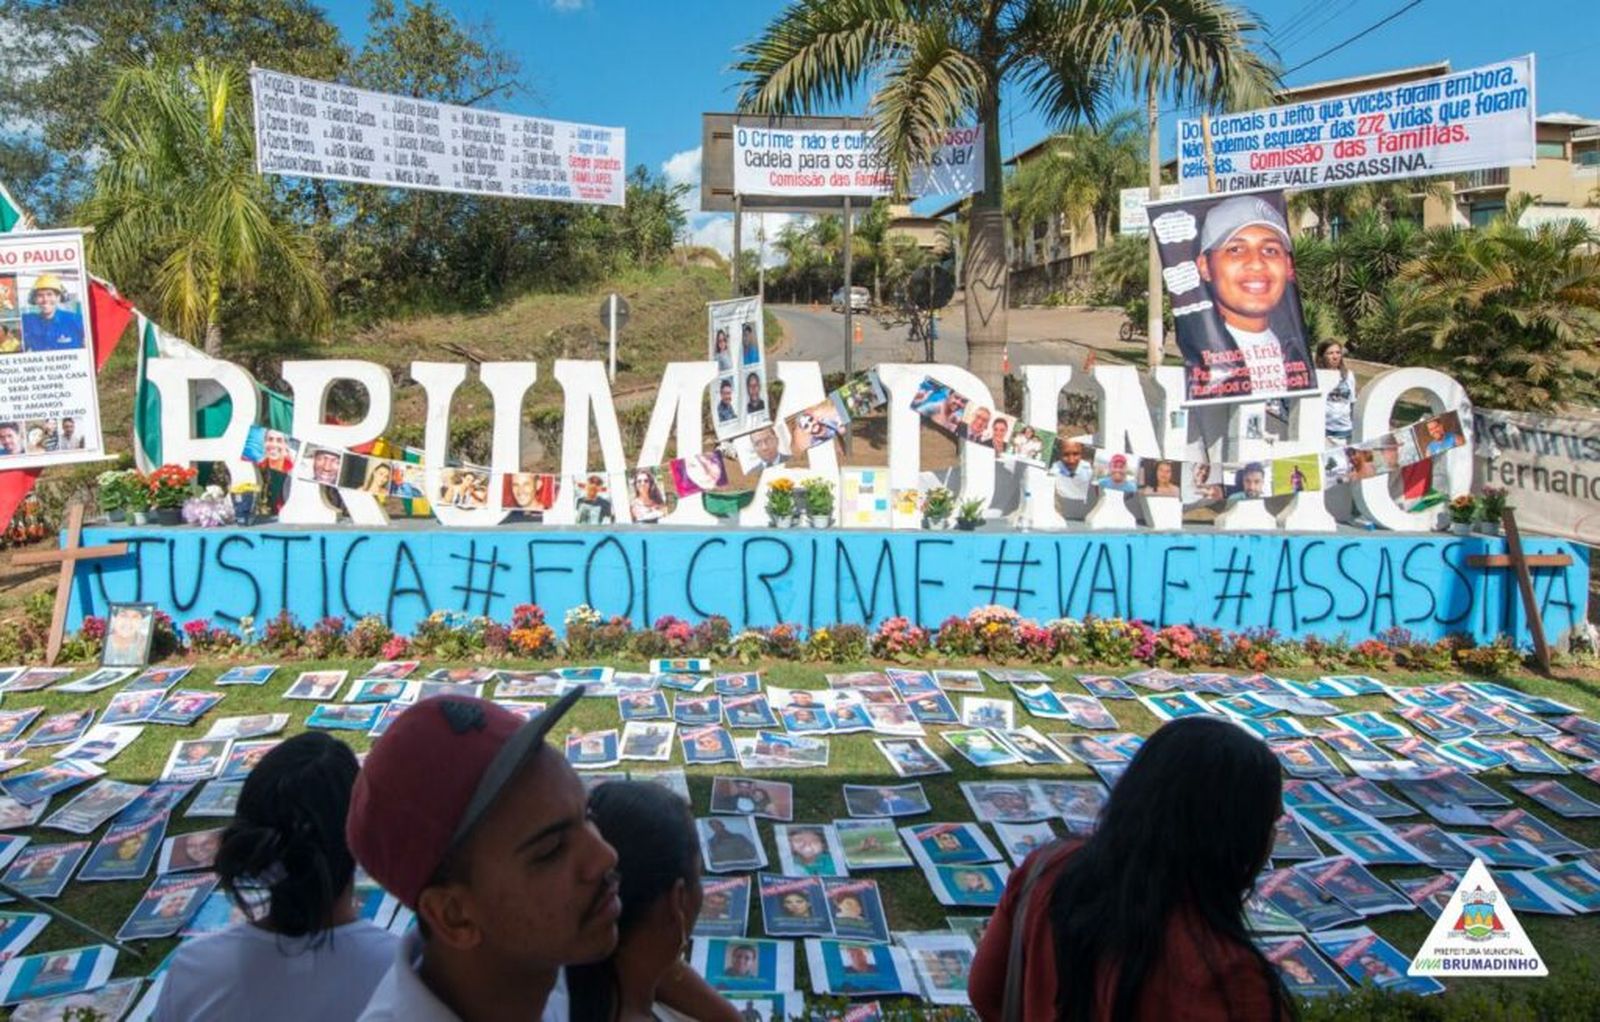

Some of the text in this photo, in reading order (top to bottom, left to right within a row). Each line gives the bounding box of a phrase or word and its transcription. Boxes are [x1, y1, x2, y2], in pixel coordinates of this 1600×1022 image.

[1210, 113, 1265, 136] demais
[1269, 113, 1277, 128] o
[1319, 99, 1344, 122] que
[1396, 84, 1441, 107] foram
[1445, 66, 1518, 96] embora.
[1212, 132, 1260, 155] odemos
[1263, 124, 1323, 150] esquecer
[1330, 117, 1356, 138] das
[1357, 113, 1387, 137] 272
[1439, 97, 1471, 125] que
[1475, 87, 1528, 117] foram
[738, 129, 747, 147] O
[752, 129, 794, 148] Crime
[1250, 142, 1324, 171] Comissão
[1333, 137, 1367, 160] das
[744, 149, 792, 169] Cadeia
[799, 153, 830, 172] para
[836, 153, 854, 169] os
[1323, 152, 1434, 184] ASSASSINA.
[829, 171, 850, 187] das
[23, 247, 76, 264] PAULO
[146, 358, 1473, 531] BRUMADINHO
